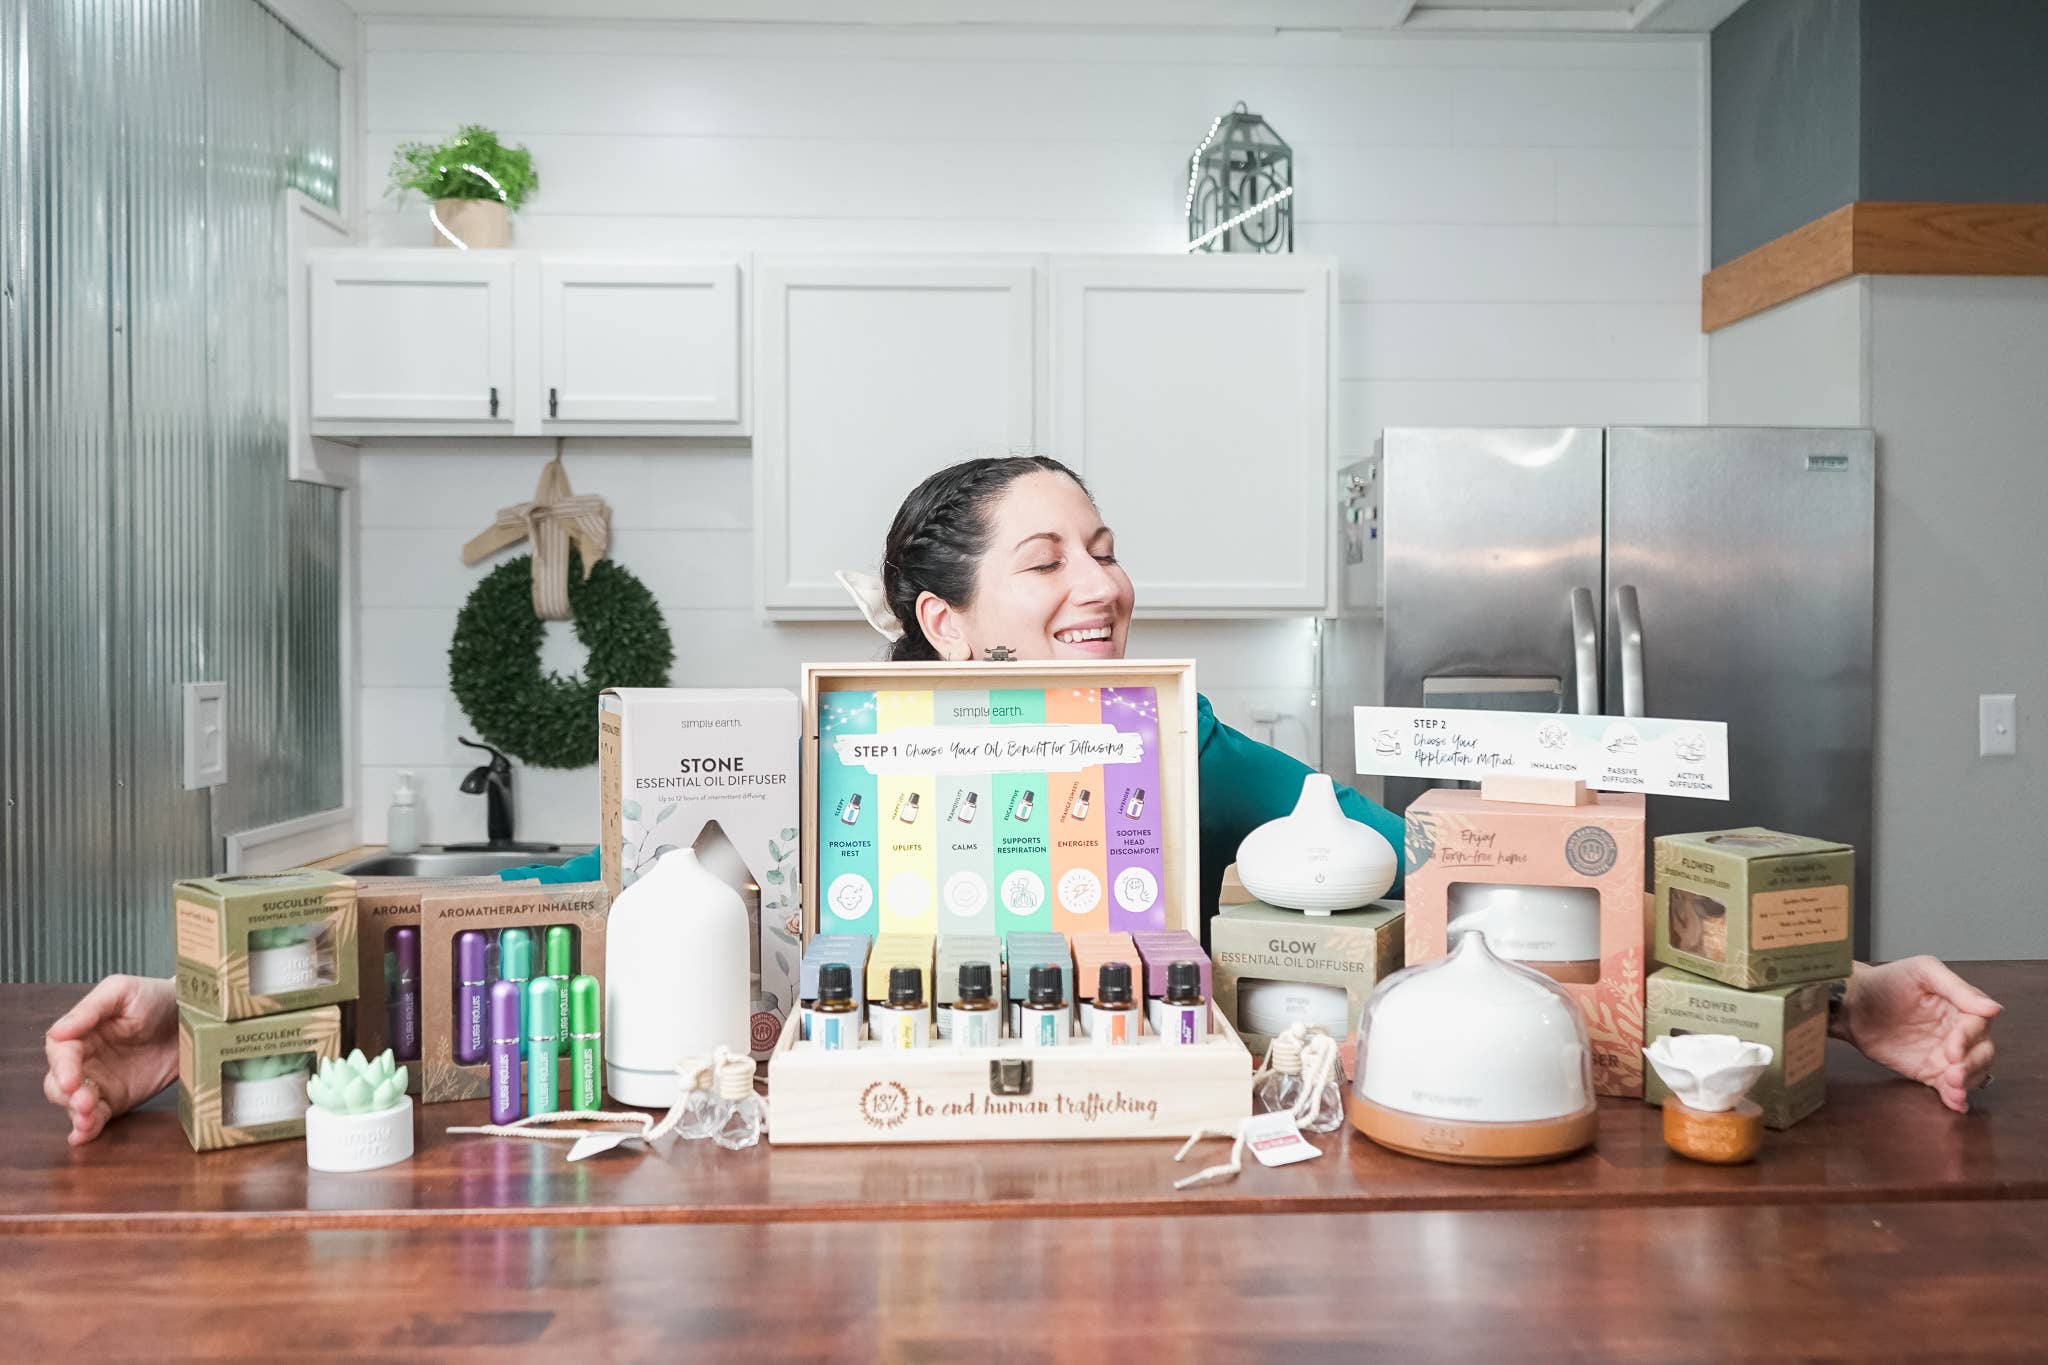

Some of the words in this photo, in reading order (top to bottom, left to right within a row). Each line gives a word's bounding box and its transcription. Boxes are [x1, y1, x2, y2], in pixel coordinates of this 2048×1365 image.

[953, 706, 990, 718] simply
[681, 720, 714, 728] simply
[1414, 719, 1438, 729] STEP
[1441, 720, 1446, 729] 2
[854, 746, 889, 757] STEP
[892, 746, 897, 757] 1
[905, 744, 944, 757] Choose
[950, 741, 981, 759] Your
[984, 741, 1002, 757] Oil
[1007, 741, 1050, 757] Benefit
[1051, 741, 1064, 756] for
[1069, 740, 1124, 756] Diffusing
[1414, 733, 1446, 746] Choose
[1452, 735, 1478, 750] Your
[681, 757, 743, 773] STONE
[1415, 749, 1472, 767] Application
[1476, 753, 1515, 768] Method
[1530, 762, 1577, 771] INHALATION
[1602, 775, 1644, 784] DIFFUSION
[1608, 767, 1638, 776] PASSIVE
[636, 777, 701, 789] ESSENTIAL
[704, 776, 725, 786] OIL
[728, 774, 787, 786] DIFFUSER
[1669, 780, 1713, 790] DIFFUSION
[835, 798, 845, 816] SLEEPY
[947, 789, 964, 821] TRANQUILITY
[1004, 789, 1020, 821] EUCALYPTUS
[1118, 787, 1130, 814] LAVENDER
[1060, 801, 1072, 823] ORANGE
[1002, 837, 1041, 845] SUPPORTS
[1116, 829, 1151, 837] SOOTHES
[1461, 829, 1496, 848] Enjoy
[1058, 840, 1099, 848] ENERGIZES
[1110, 848, 1159, 856] DISCOMFORT
[1497, 852, 1528, 865] home
[1682, 858, 1715, 873] FLOWER
[263, 895, 324, 911] SUCCULENT
[372, 904, 421, 916] AROMAT
[439, 904, 535, 918] AROMATHERAPY
[538, 901, 594, 913] INHALERS
[249, 912, 287, 923] ESSENTIAL
[289, 910, 302, 918] OIL
[303, 905, 338, 916] DIFFUSER
[1268, 939, 1317, 955] GLOW
[1221, 951, 1281, 967] ESSENTIAL
[1283, 956, 1303, 968] OIL
[1306, 958, 1365, 973] DIFFUSER
[472, 995, 480, 1023] simply
[560, 989, 568, 1016] simply
[1689, 997, 1737, 1013] FLOWER
[236, 1028, 300, 1044] SUCCULENT
[220, 1045, 262, 1055] ESSENTIAL
[279, 1039, 318, 1049] DIFFUSER
[500, 1054, 509, 1084] simply
[584, 1049, 593, 1078] simply
[916, 1096, 935, 1117] to
[942, 1092, 974, 1116] end
[984, 1095, 1049, 1116] human
[1056, 1091, 1158, 1122] trafficking
